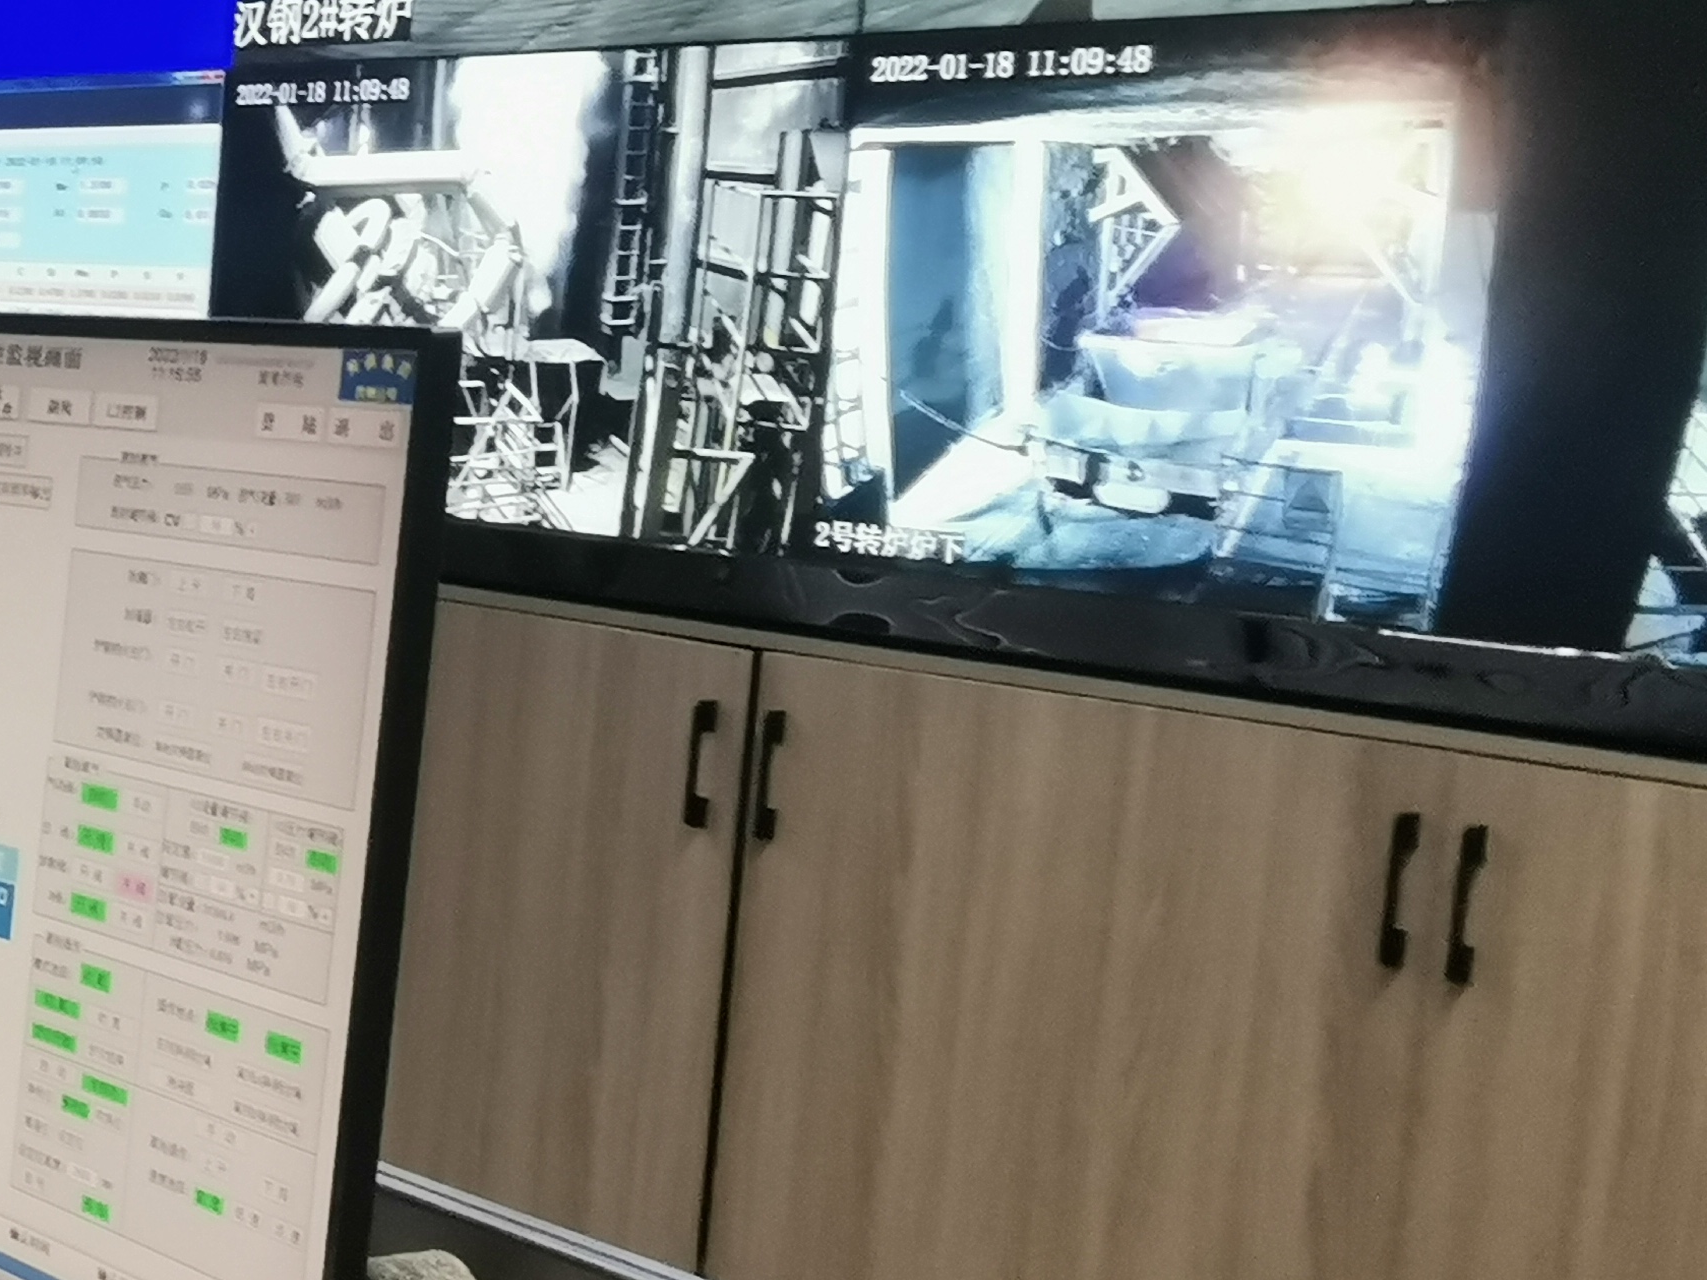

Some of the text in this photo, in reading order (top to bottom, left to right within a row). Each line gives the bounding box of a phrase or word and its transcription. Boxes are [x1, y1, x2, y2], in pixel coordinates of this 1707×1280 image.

[870, 44, 1153, 82] 2022-01-18 11:09:48
[235, 76, 411, 106] 2022-01-18 11:09:48
[813, 520, 967, 565] 2号转炉炉下
